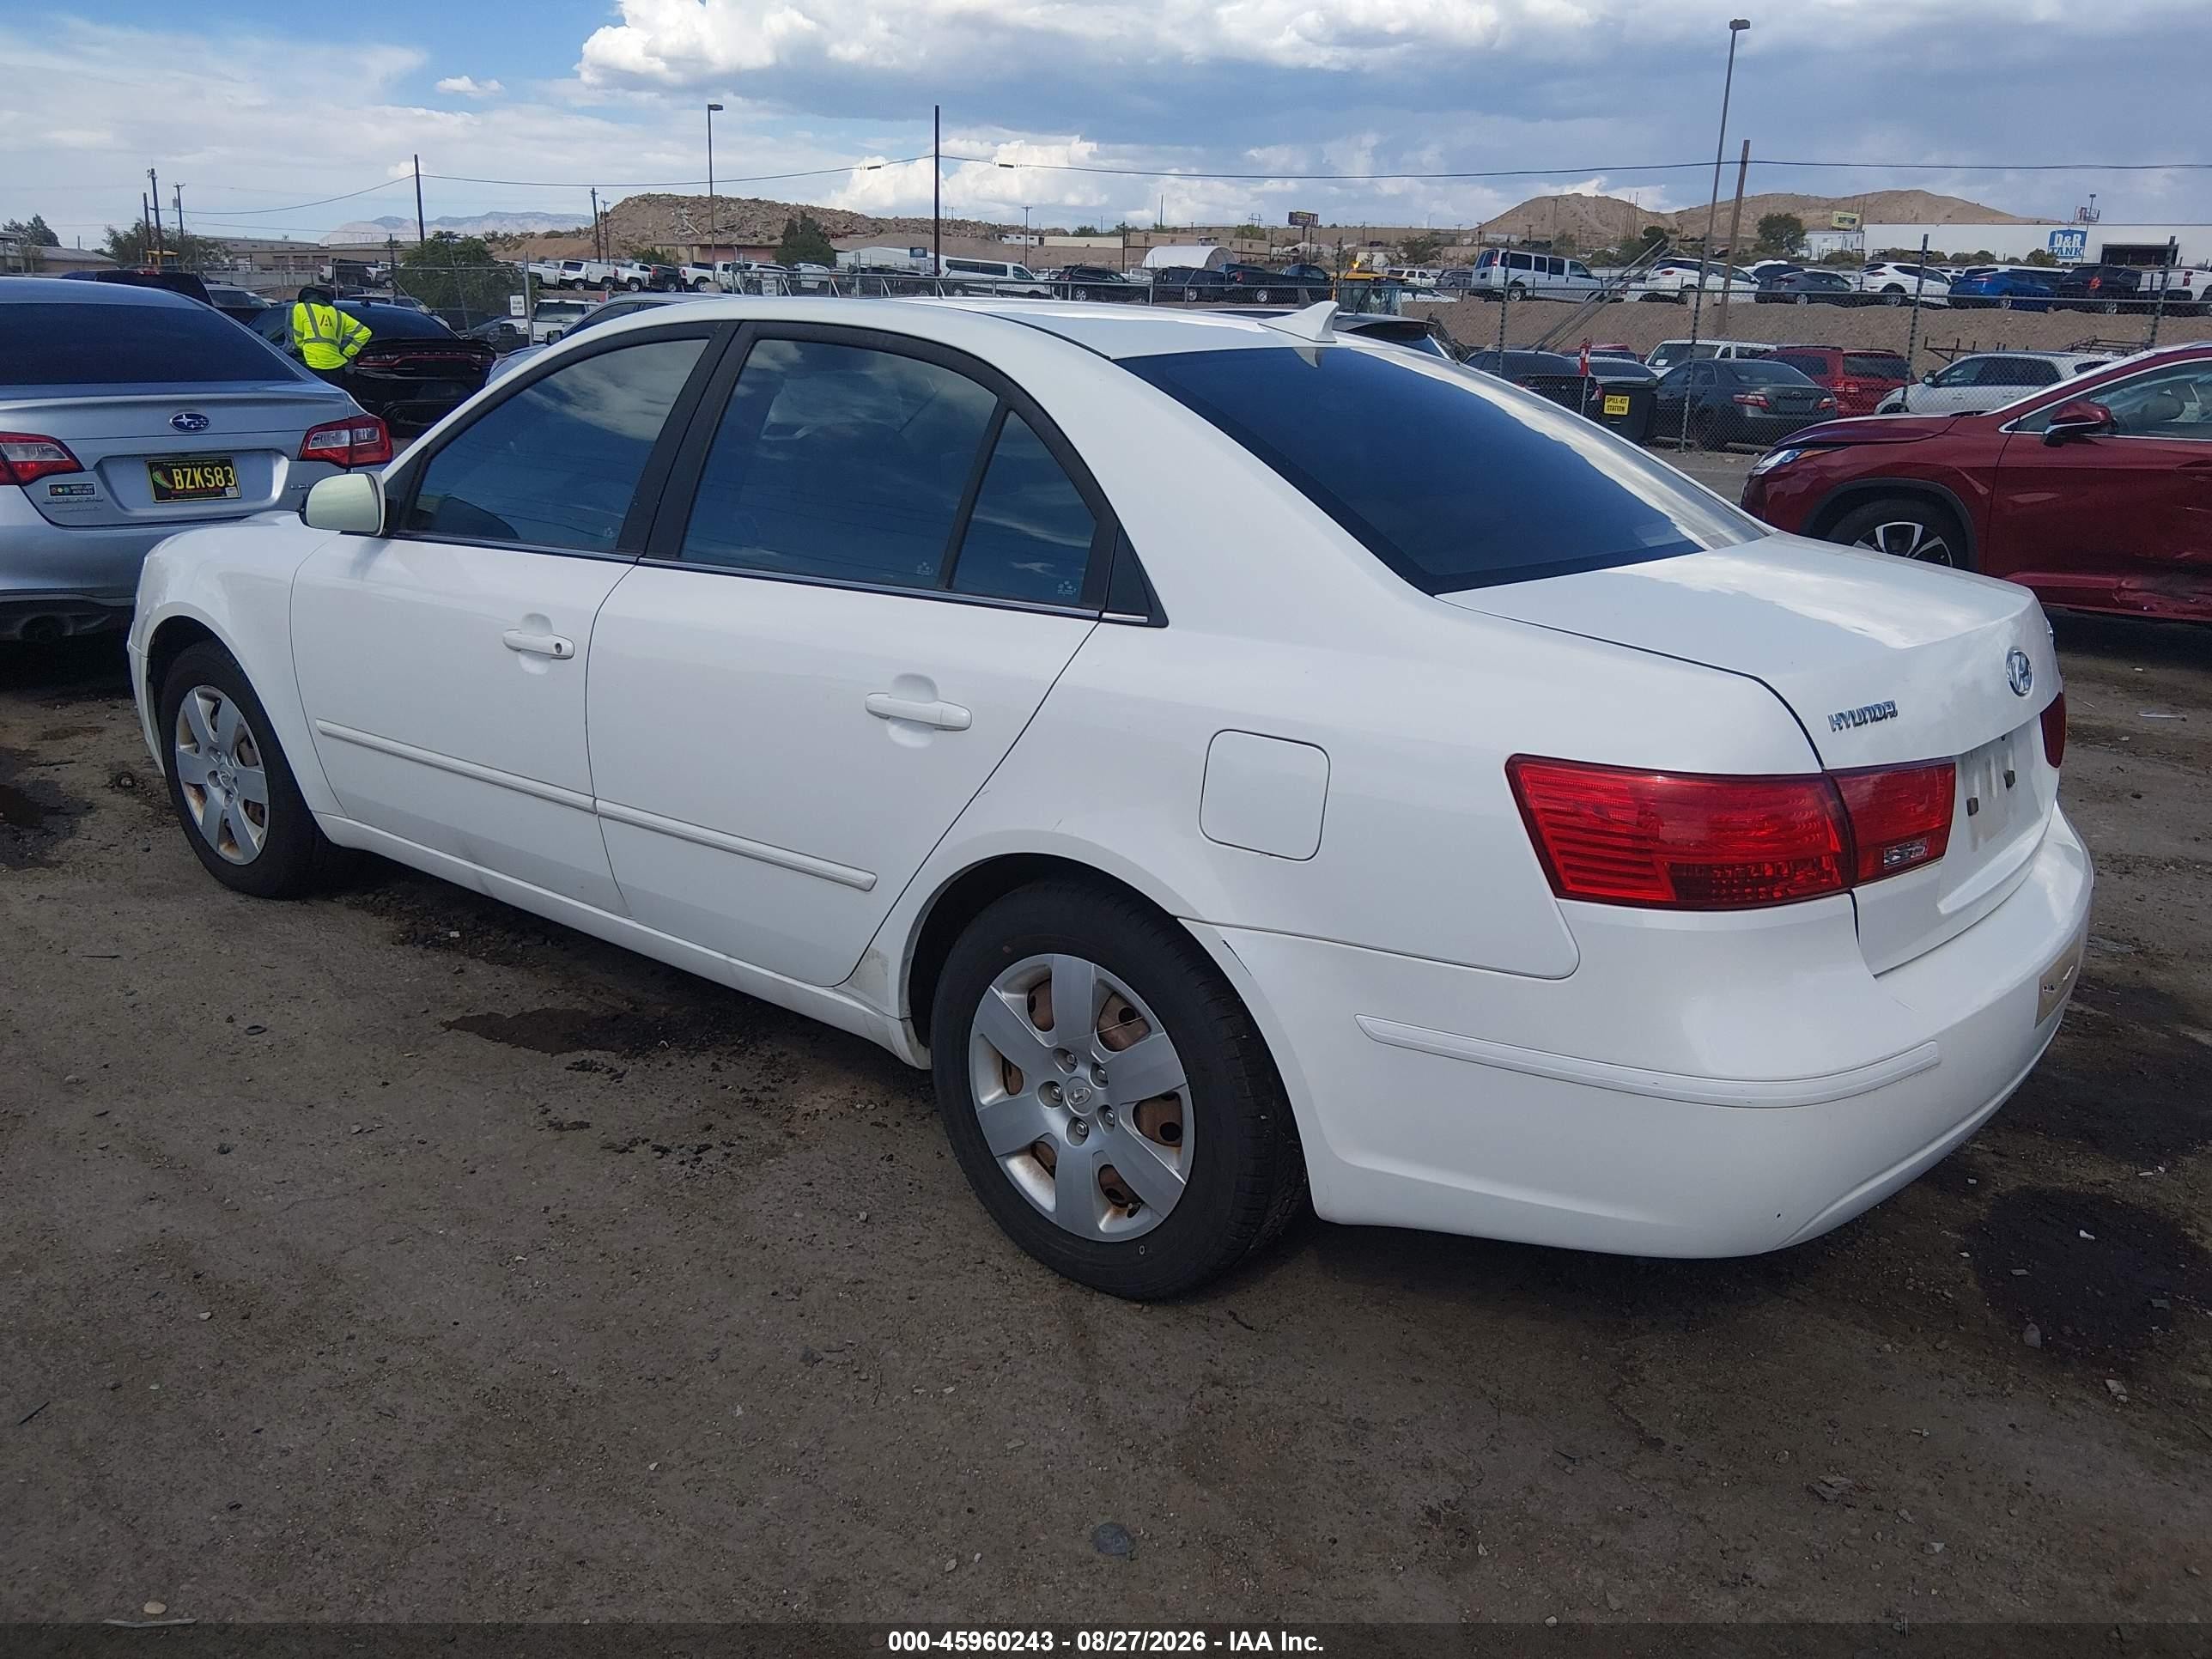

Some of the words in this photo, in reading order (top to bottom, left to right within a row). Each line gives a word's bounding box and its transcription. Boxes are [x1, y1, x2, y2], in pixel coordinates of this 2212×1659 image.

[2055, 233, 2081, 247] D&R
[2050, 247, 2083, 257] TANK
[172, 466, 235, 489] BZKS83
[1827, 700, 1898, 732] HYUNDAI
